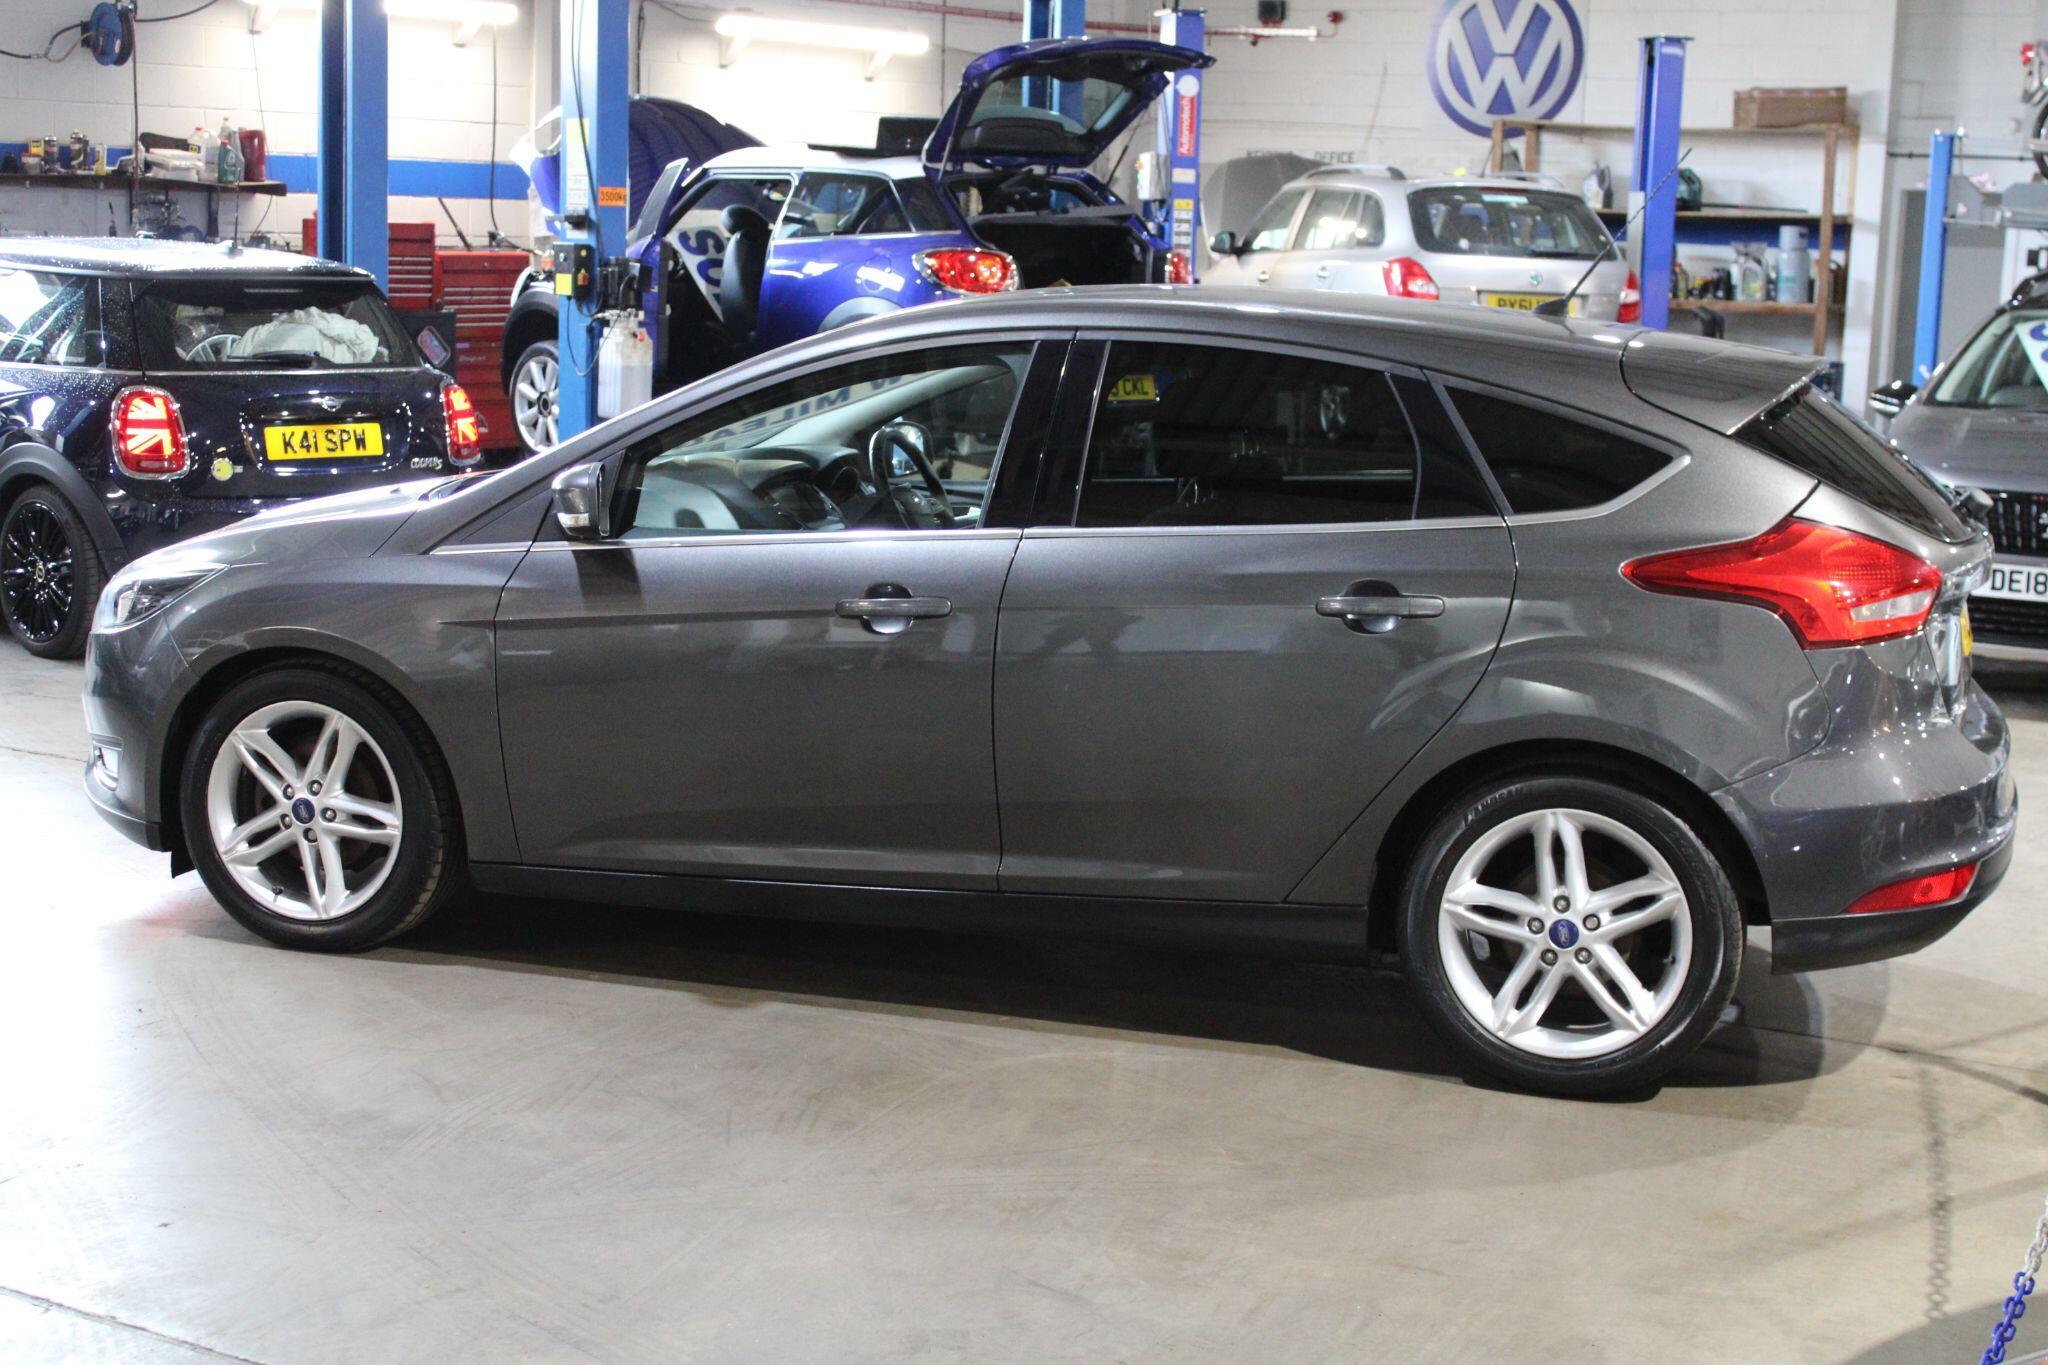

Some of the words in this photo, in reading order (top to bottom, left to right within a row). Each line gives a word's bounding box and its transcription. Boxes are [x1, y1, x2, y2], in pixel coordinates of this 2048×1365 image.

[282, 431, 318, 455] K41
[324, 428, 366, 452] SPW
[1991, 569, 2048, 595] DE18
